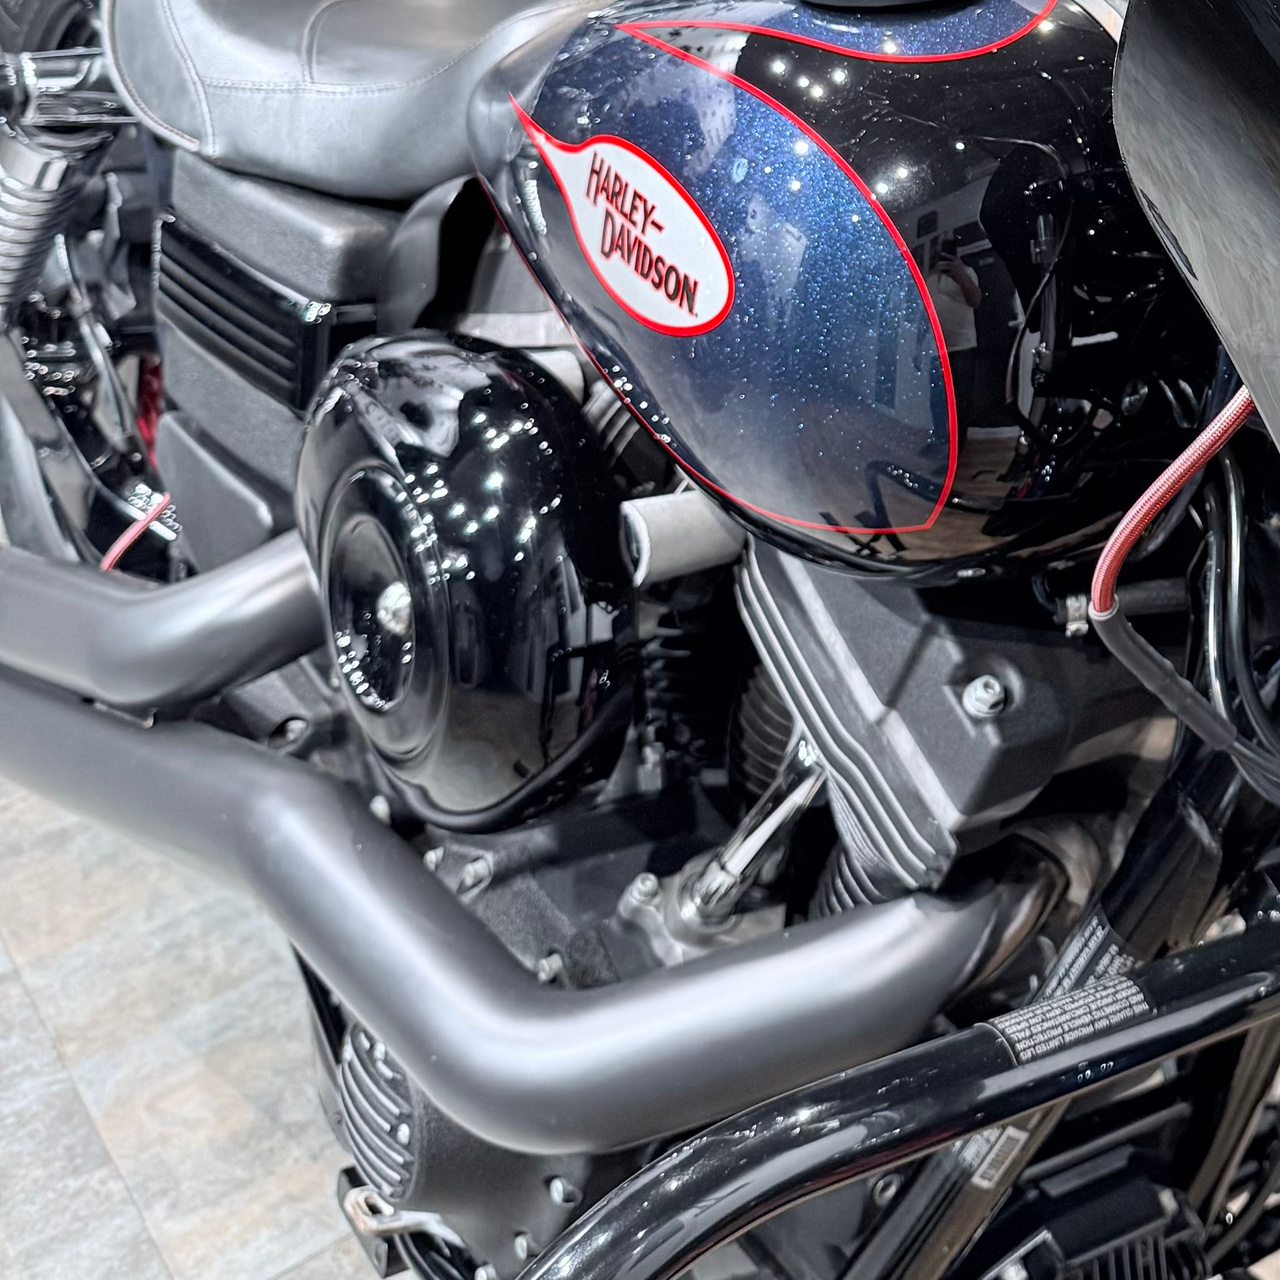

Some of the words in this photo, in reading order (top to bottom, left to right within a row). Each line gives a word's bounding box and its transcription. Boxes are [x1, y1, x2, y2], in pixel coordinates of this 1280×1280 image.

[586, 151, 665, 235] HARLEY-
[1091, 997, 1130, 1020] COSMETIC
[1060, 1012, 1094, 1032] VEHICLE
[1062, 1022, 1095, 1042] PROVIDE
[1014, 1024, 1063, 1051] PROTECTION
[1034, 1034, 1064, 1054] LIMITED
[1018, 1046, 1036, 1060] LEG
